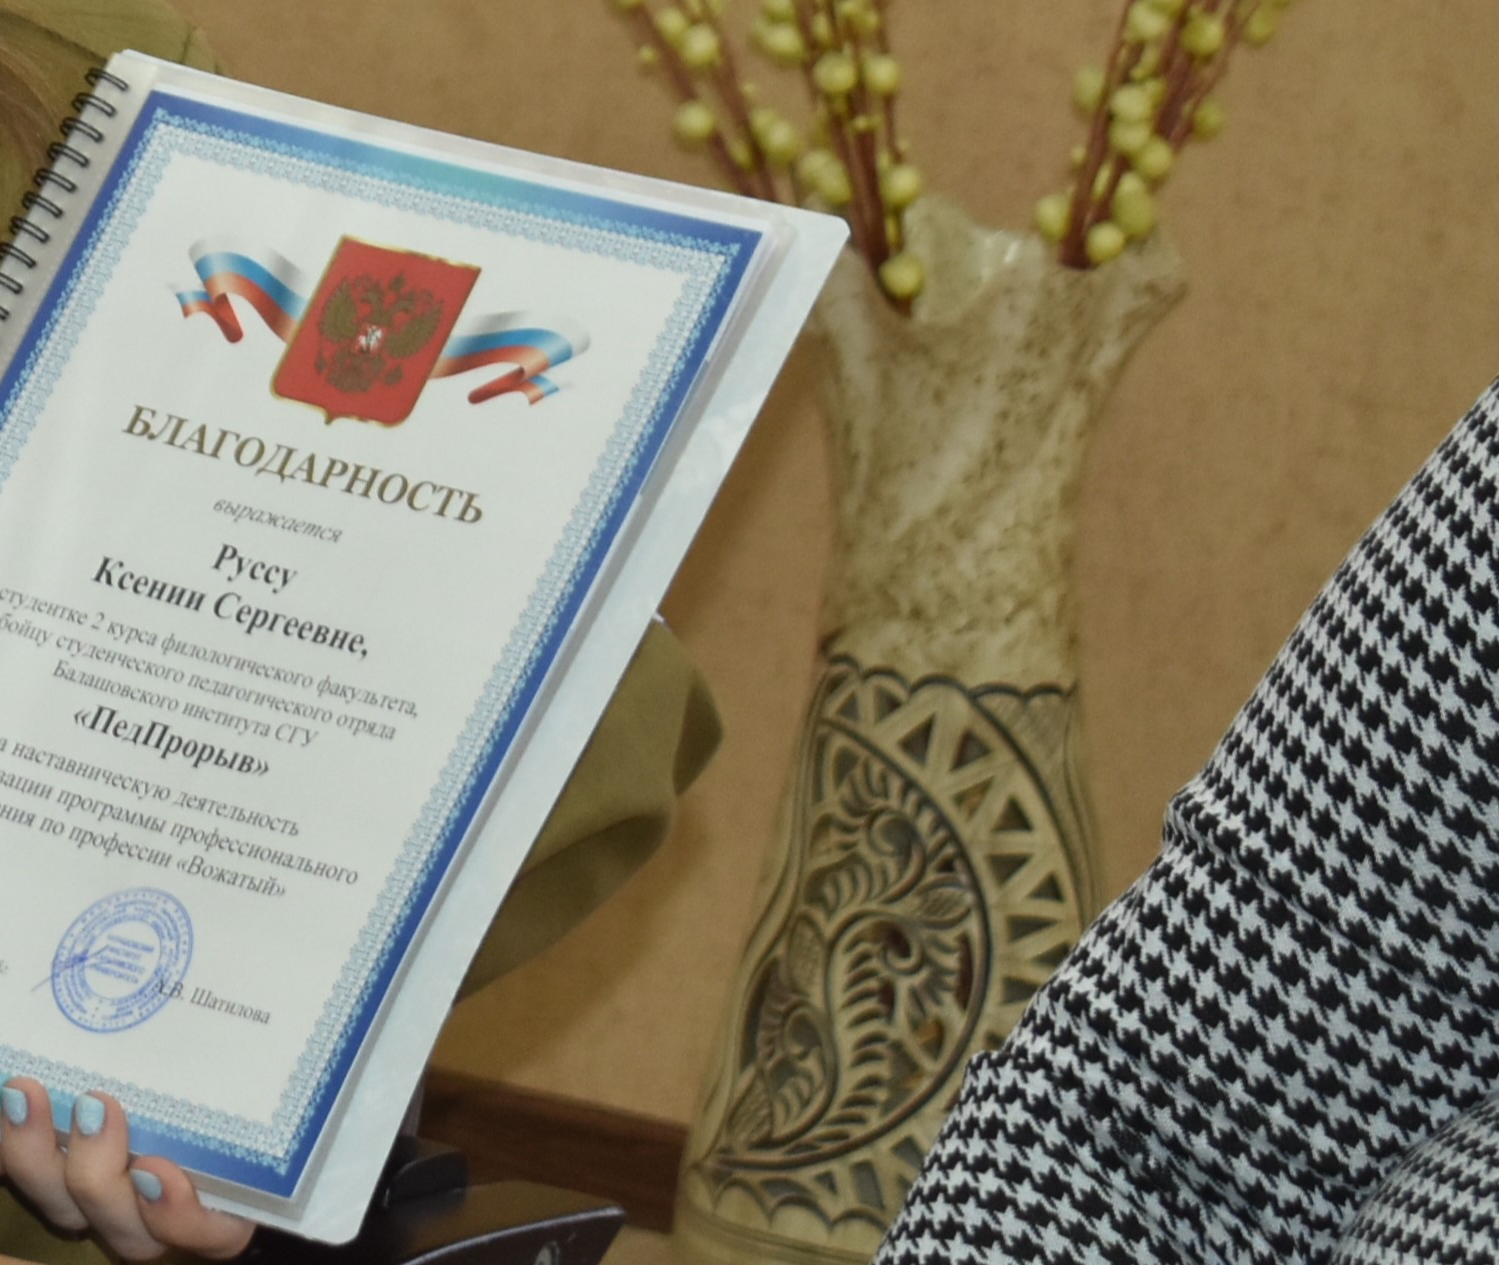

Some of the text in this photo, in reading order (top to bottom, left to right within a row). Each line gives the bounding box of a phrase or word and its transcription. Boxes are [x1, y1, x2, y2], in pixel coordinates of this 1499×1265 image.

[123, 405, 482, 523] БЛАГОДАРНОСТЬ
[213, 500, 342, 542] выражается
[94, 557, 367, 657] Ксении Сергеевне,
[213, 544, 298, 594] Руссу
[53, 660, 316, 746] Балашовского института СГУ
[56, 637, 184, 682] студенческого
[187, 675, 332, 721] педагогического
[336, 715, 395, 740] отряда
[91, 612, 104, 629] 2
[107, 622, 157, 646] курса
[161, 633, 313, 687] филологического
[316, 676, 417, 717] факультета,
[74, 706, 268, 773] «ПедПрорыв»
[12, 743, 170, 800] наставническую
[179, 793, 298, 835] деятельность
[39, 818, 64, 835] по
[68, 827, 171, 867] профессии
[176, 855, 284, 895] «Вожатый»
[57, 790, 166, 833] программы
[170, 823, 357, 884] профессионального
[190, 987, 270, 1024] Шатилова
